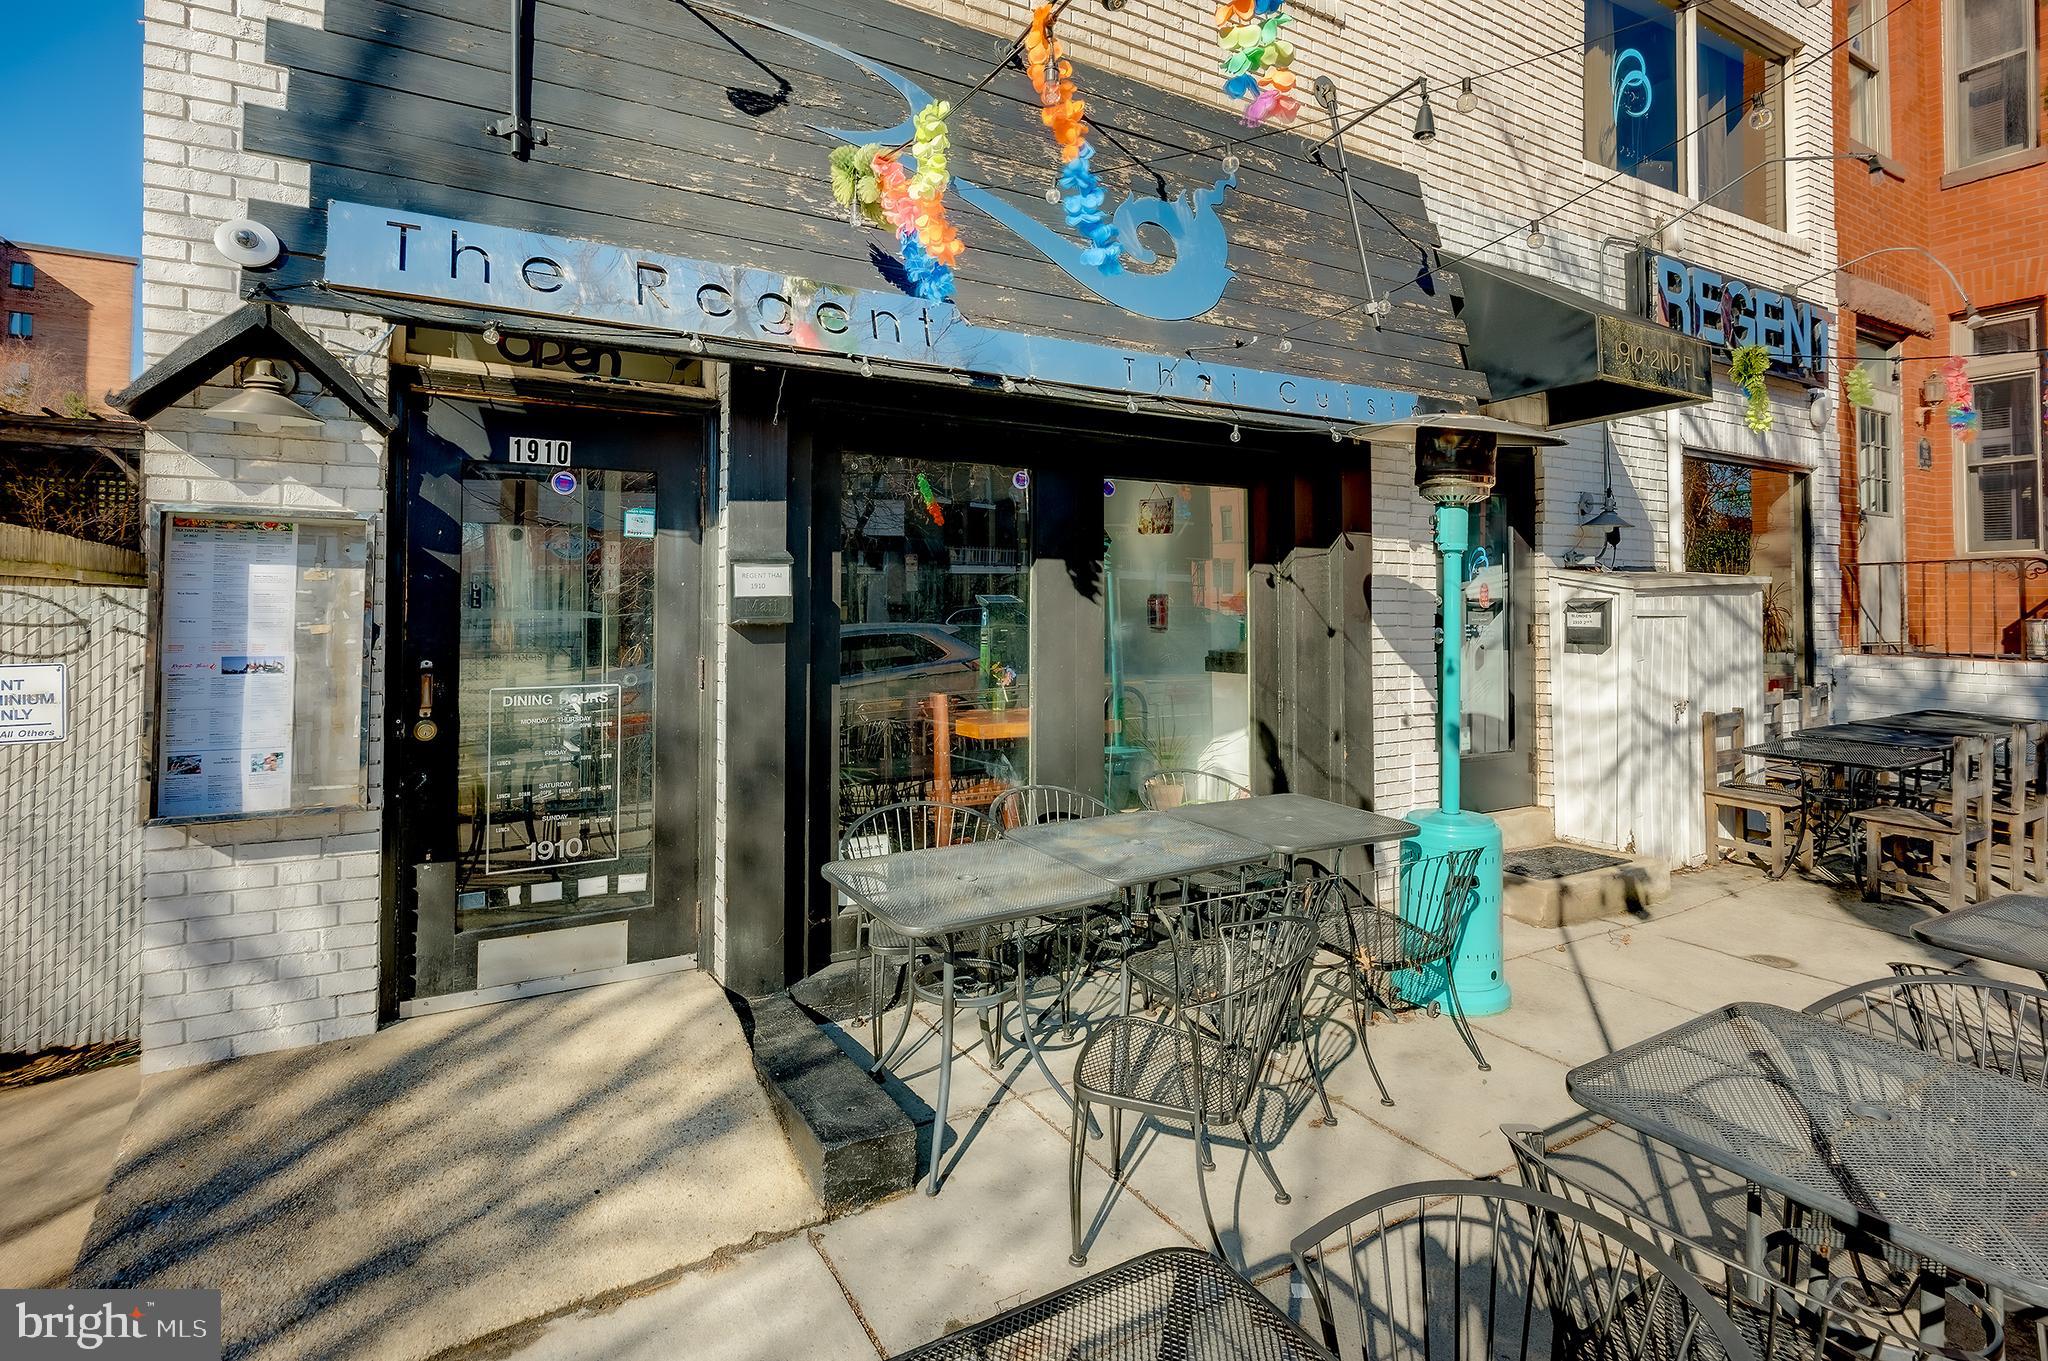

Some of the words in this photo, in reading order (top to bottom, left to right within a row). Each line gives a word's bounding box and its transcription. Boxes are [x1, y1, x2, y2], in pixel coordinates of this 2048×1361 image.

[386, 220, 564, 293] The
[636, 260, 936, 348] Regent
[1656, 254, 1829, 373] REGENT
[497, 334, 622, 378] open
[1683, 355, 1706, 384] FL
[1123, 356, 1238, 397] Thai
[1279, 380, 1448, 417] Cuisin
[513, 438, 569, 465] 1910
[0, 692, 55, 706] INIUM
[502, 694, 553, 707] DINING
[559, 692, 609, 704] HOURS
[520, 717, 549, 725] MONDAY
[558, 715, 591, 723] THURSDAY
[18, 729, 55, 737] Others
[538, 781, 572, 790] SATURDAY
[541, 814, 569, 822] SUNDAY
[526, 837, 583, 862] 1910
